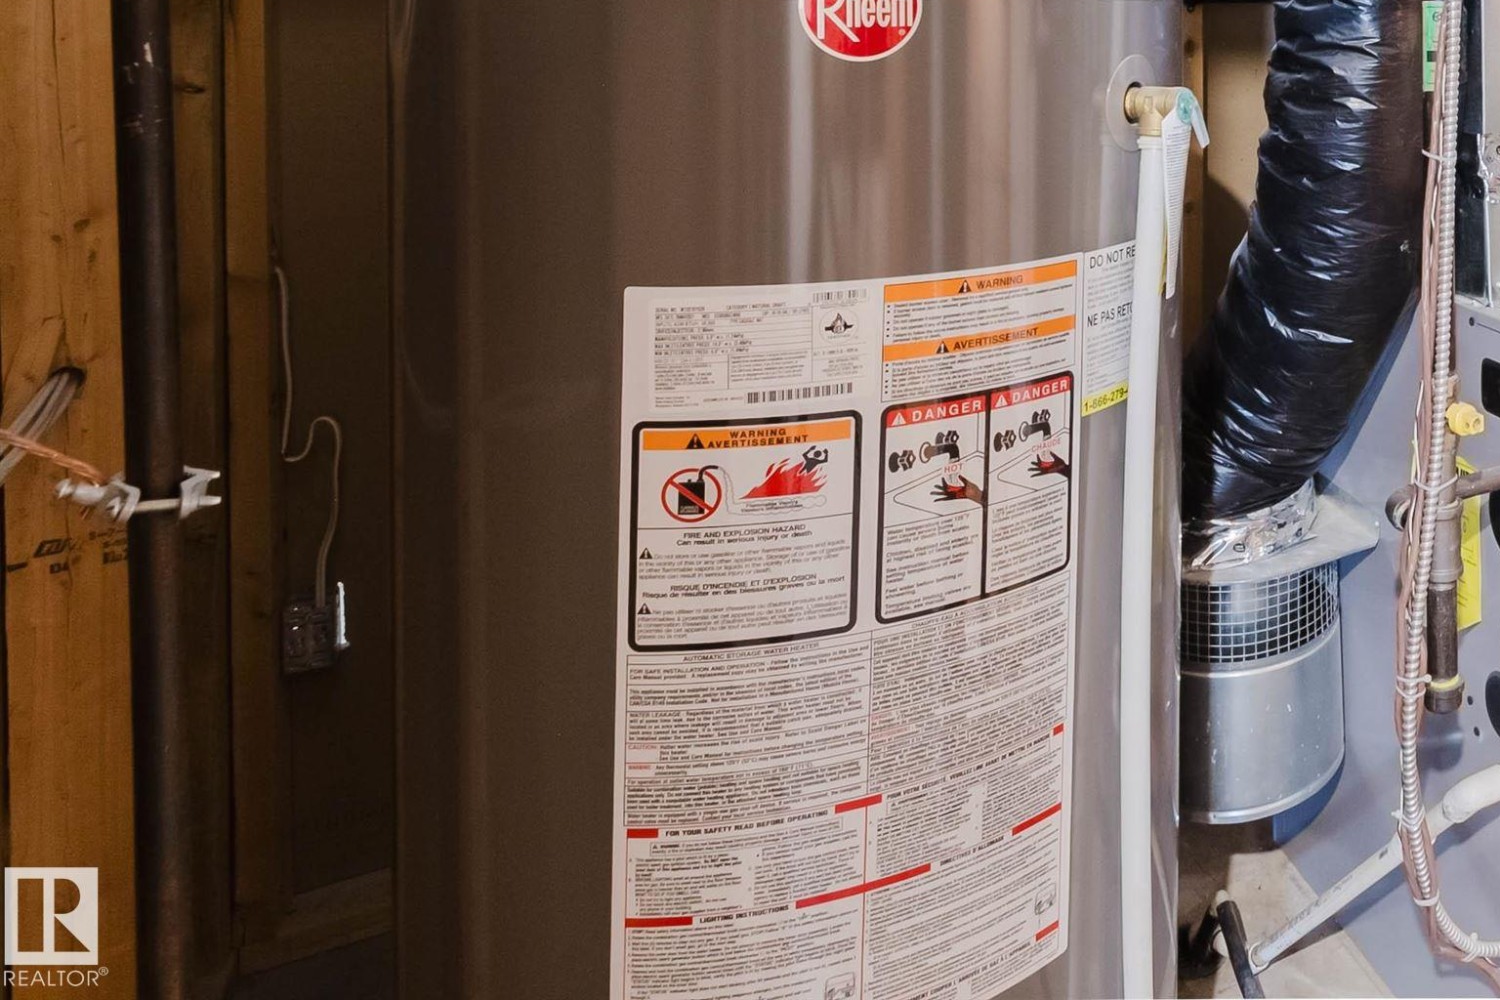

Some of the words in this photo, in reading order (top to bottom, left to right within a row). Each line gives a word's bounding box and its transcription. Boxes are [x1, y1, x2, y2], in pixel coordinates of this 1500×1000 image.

[1089, 254, 1104, 269] DO
[1106, 248, 1124, 264] NOT
[976, 274, 1023, 289] WARNING
[1087, 312, 1098, 328] NE
[1100, 307, 1115, 322] PAS
[953, 327, 1039, 351] AVERTISSEMENT
[1011, 379, 1068, 403] DANGER
[911, 399, 982, 423] DANGER
[707, 435, 809, 448] AVERTISSEMENT
[730, 428, 787, 439] WARNING
[944, 463, 964, 473] HOT
[694, 537, 715, 545] result
[727, 535, 755, 543] serious
[757, 533, 778, 542] injury
[791, 530, 812, 538] death
[704, 530, 721, 538] AND
[723, 527, 770, 537] EXPLOSION
[772, 524, 806, 533] HAZARD
[683, 653, 725, 661] AUTOMATIC
[726, 650, 761, 658] STORAGE
[763, 646, 789, 655] WATER
[790, 643, 819, 652] HEATER
[665, 829, 680, 837] FOR
[682, 827, 702, 836] YOUR
[704, 825, 732, 835] SAFETY
[734, 823, 754, 832] READ
[756, 817, 785, 830] BEFORE
[787, 809, 828, 824] OPERATING
[699, 912, 734, 924] LIGHTING
[735, 905, 789, 919] INSTRUCTIONS
